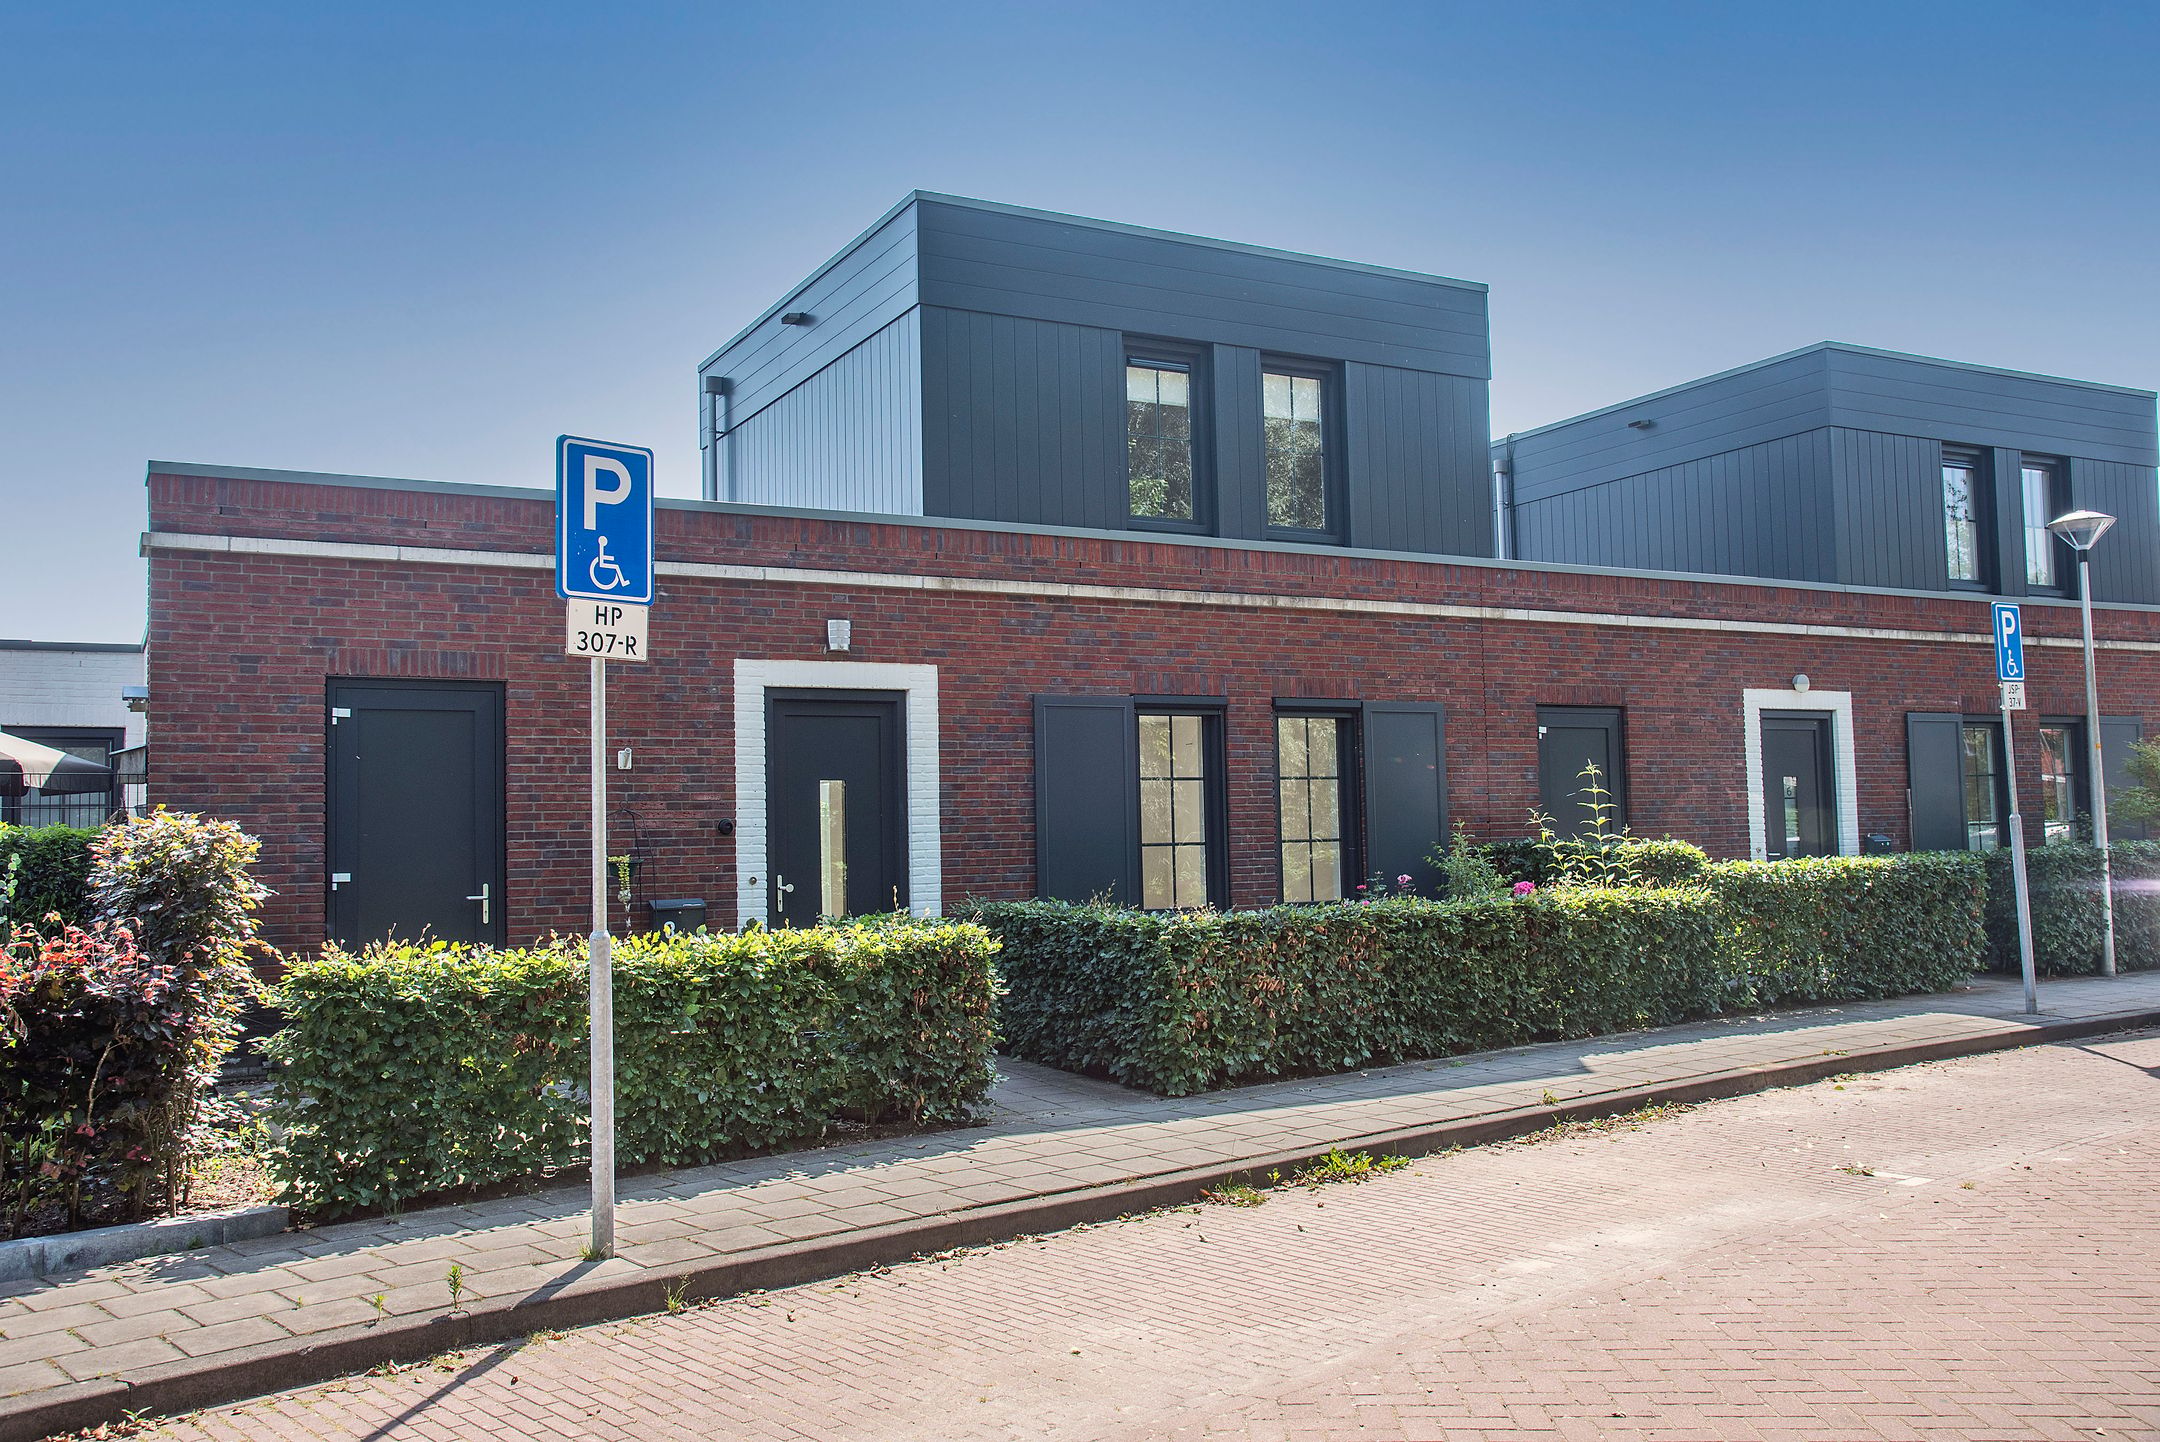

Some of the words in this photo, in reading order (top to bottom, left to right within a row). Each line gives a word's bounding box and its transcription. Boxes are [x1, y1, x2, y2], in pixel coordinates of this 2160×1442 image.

[583, 454, 632, 531] P
[595, 605, 622, 626] HP
[2001, 611, 2016, 648] P
[577, 631, 637, 655] 307-R
